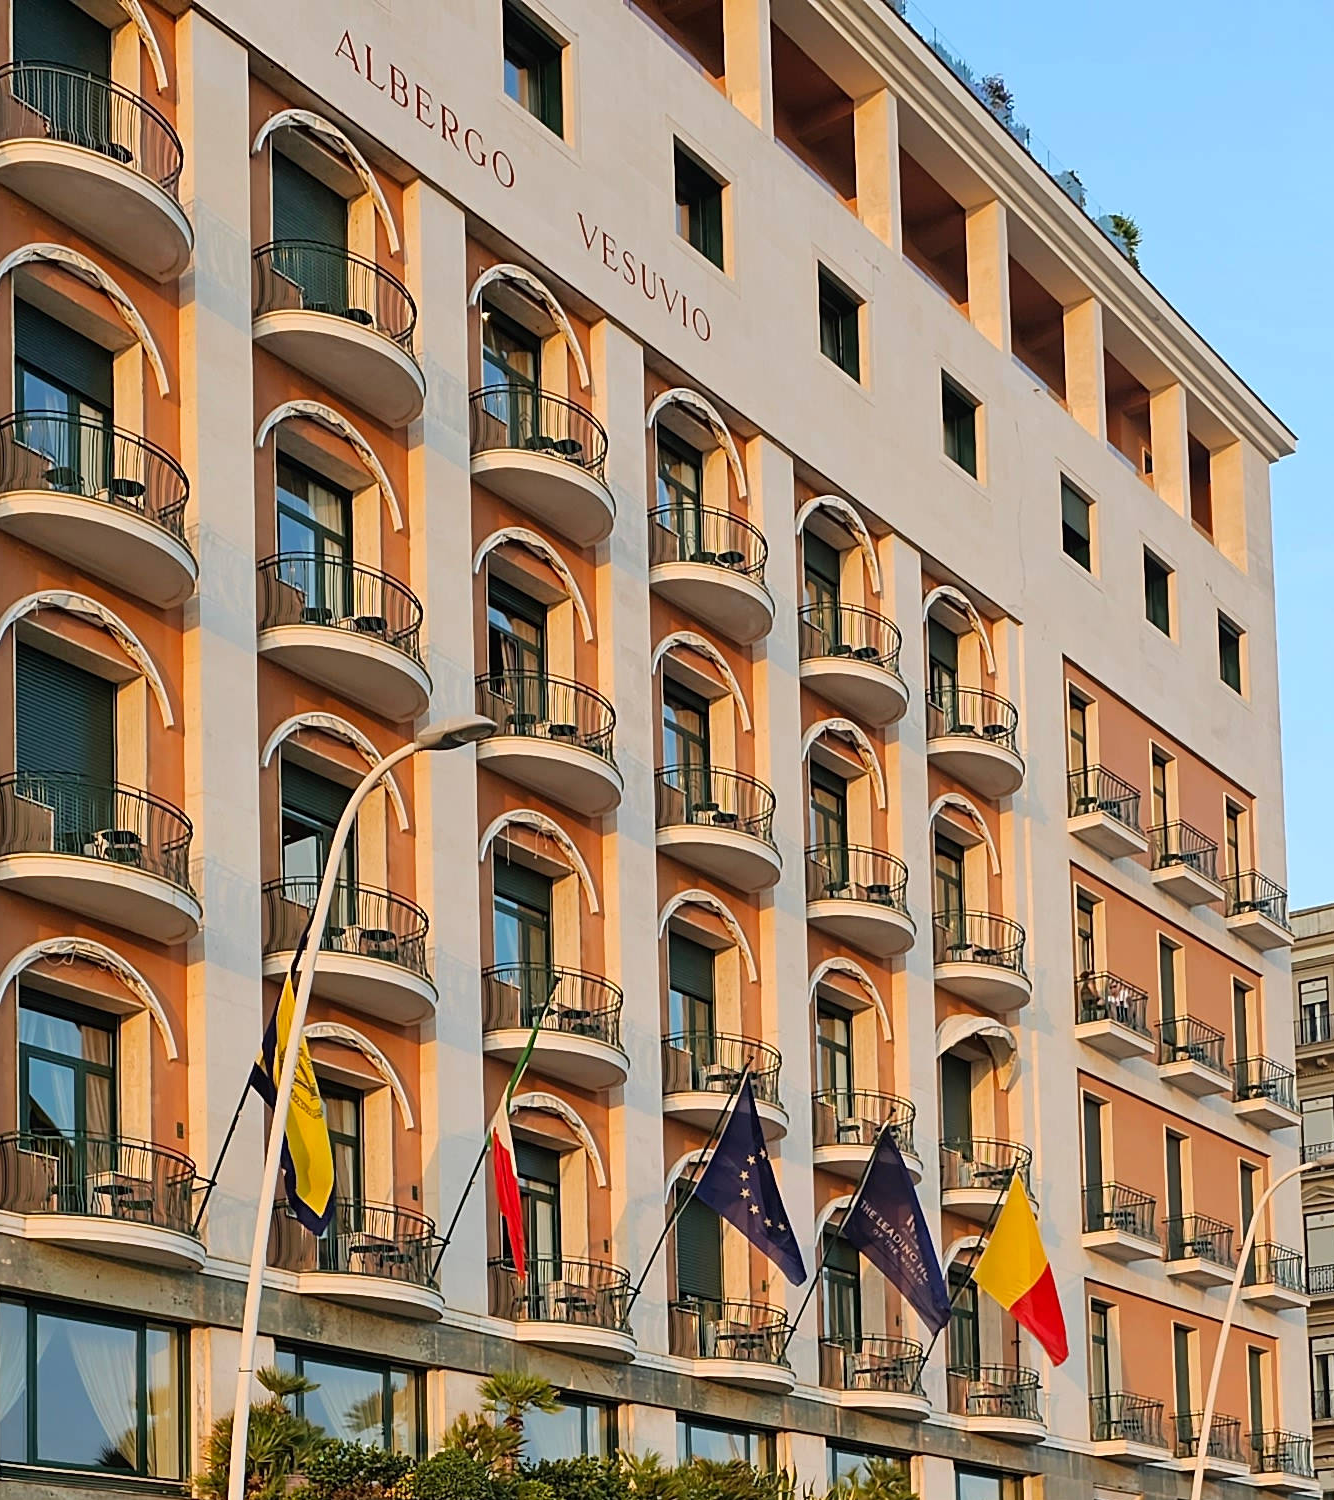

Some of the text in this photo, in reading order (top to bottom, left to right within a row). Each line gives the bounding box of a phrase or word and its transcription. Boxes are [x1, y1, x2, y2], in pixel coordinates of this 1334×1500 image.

[335, 29, 711, 342] ALBERGO VESUVIO
[860, 1200, 877, 1220] THE
[875, 1217, 919, 1262] LEADING
